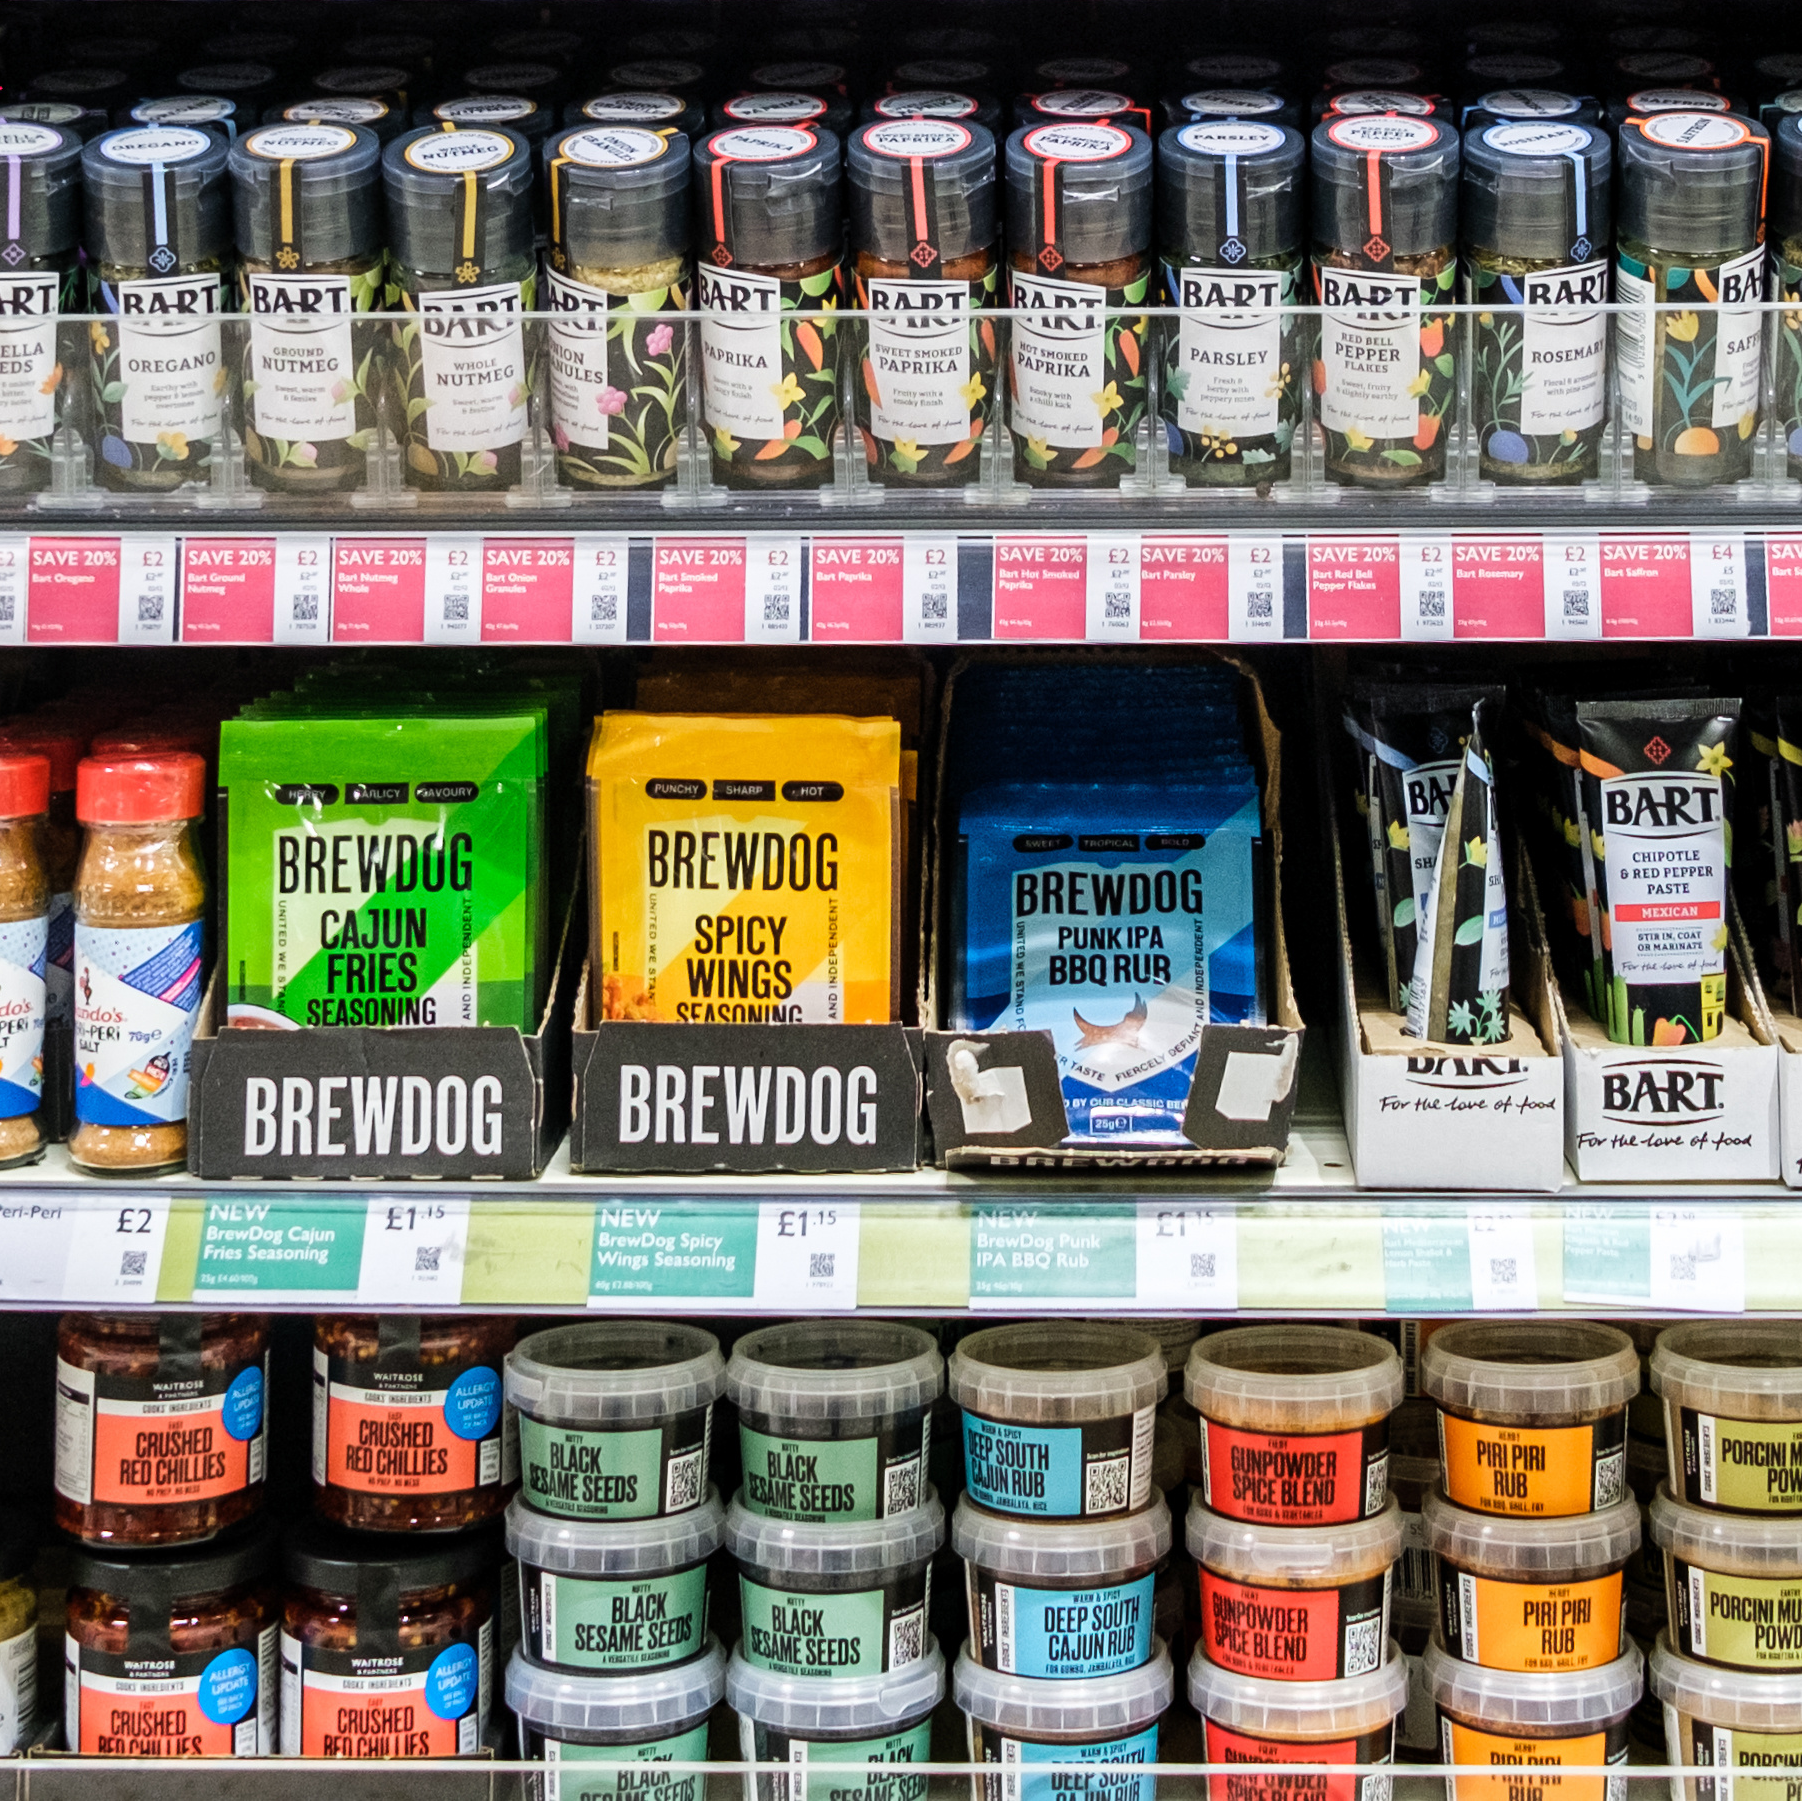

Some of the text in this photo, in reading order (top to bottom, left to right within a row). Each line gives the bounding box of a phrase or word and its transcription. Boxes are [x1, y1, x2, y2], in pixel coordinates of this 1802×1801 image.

[129, 353, 217, 372] OREGANO
[263, 357, 339, 372] NUTMEG
[880, 357, 958, 373] PAPRIKA
[1190, 349, 1267, 367] PARSLEY
[279, 831, 473, 894] BREWDOG
[648, 830, 838, 892] BREWDOG
[1632, 851, 1699, 863] CHIPOTLE
[1016, 869, 1202, 915] BREWDOG
[1647, 883, 1689, 895] PASTE
[1642, 906, 1697, 918] MEXICAN
[321, 910, 426, 949] CAJUN
[695, 916, 786, 956] SPICY
[1058, 926, 1163, 952] PUNK IPA
[328, 952, 416, 993] FRIES
[687, 959, 791, 999] WINGS
[1049, 954, 1171, 988] BBQ RUB
[245, 1075, 502, 1157] BREWDOG
[620, 1065, 877, 1145] BREWDOG
[117, 1208, 152, 1234] £2
[136, 1427, 212, 1458] CRUSHED
[1477, 1441, 1546, 1470] PIRI PIRI
[1722, 1438, 1786, 1467] PORCINI
[120, 1451, 225, 1485] RED CHILLIES
[1231, 1450, 1336, 1477] GUNPOWDER
[1233, 1475, 1335, 1505] SPICE BLEND
